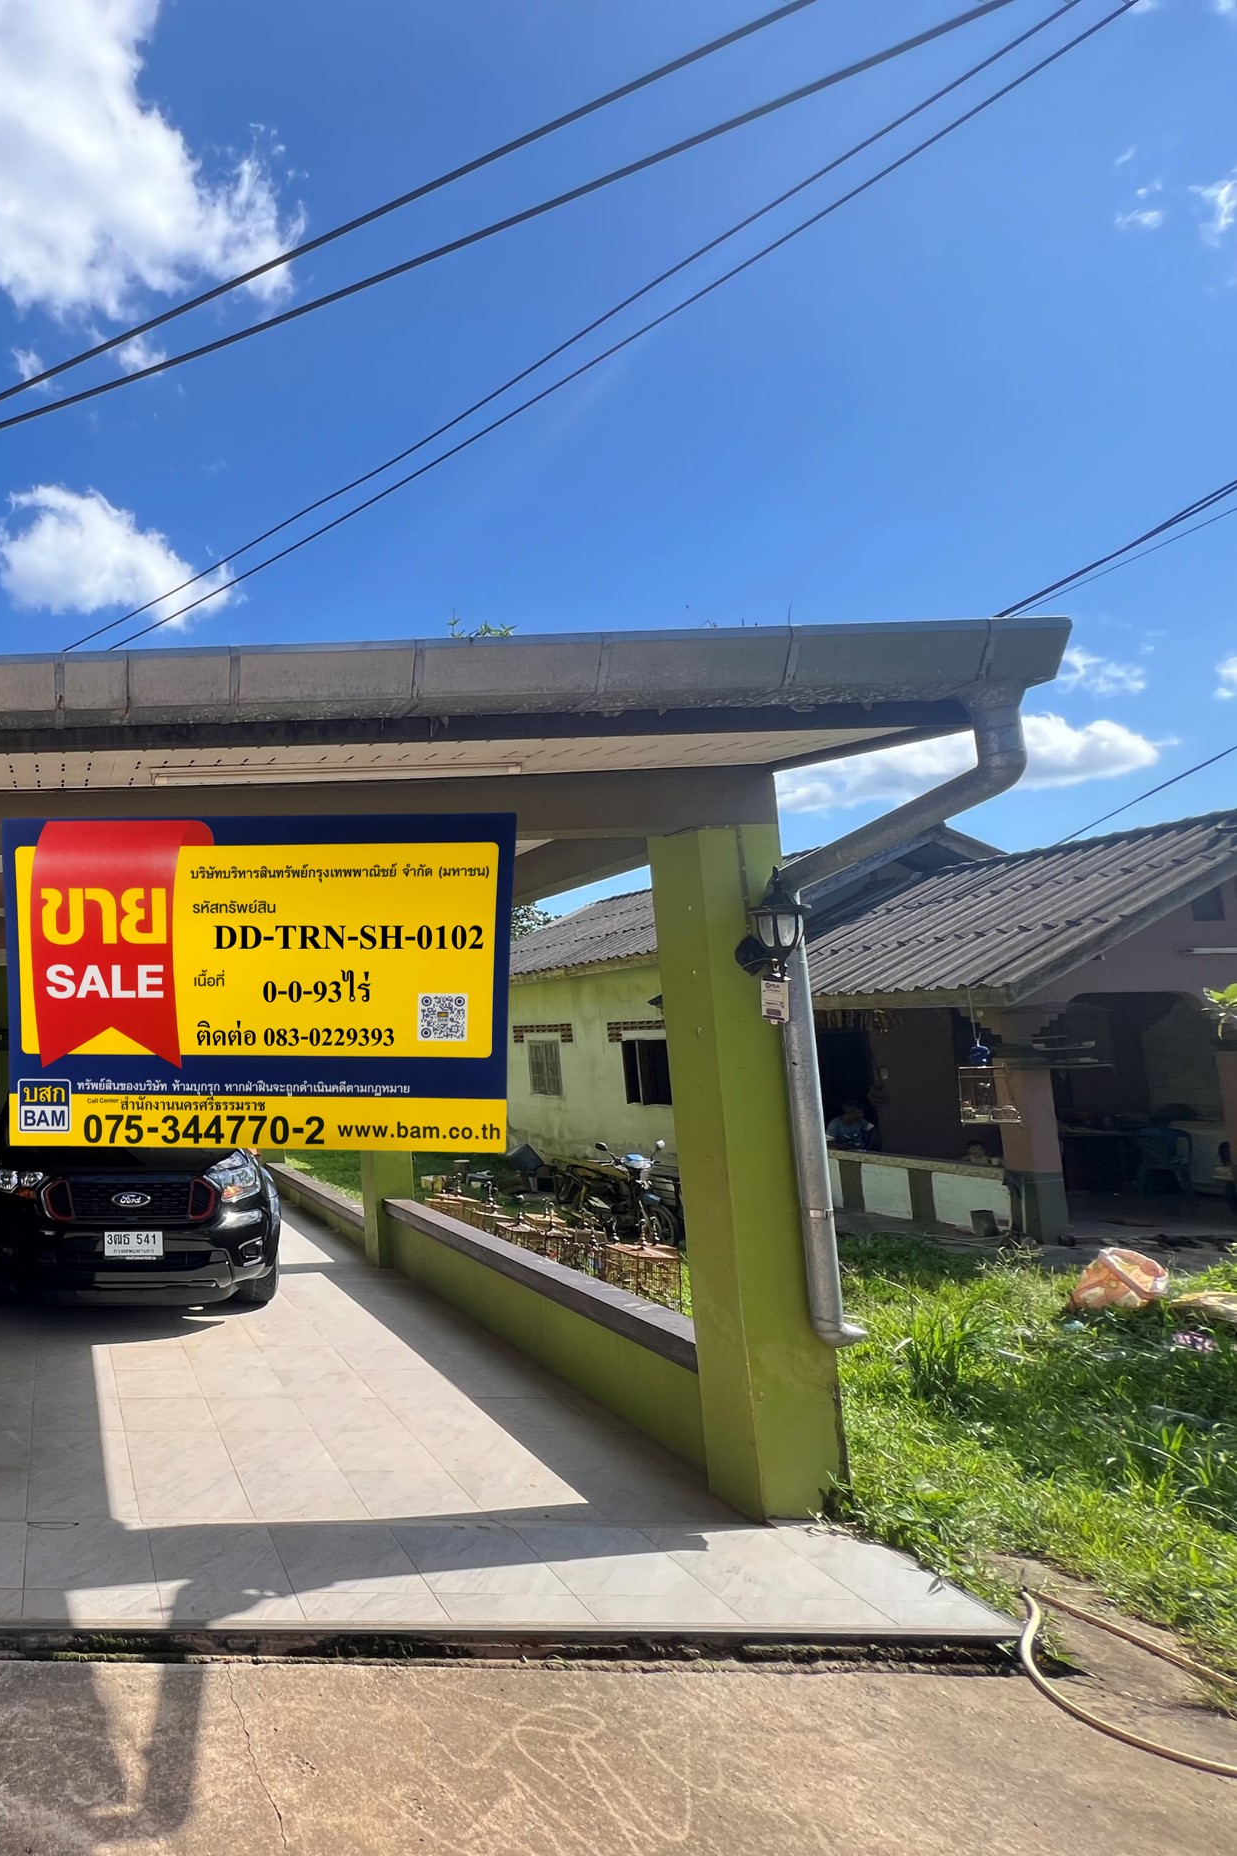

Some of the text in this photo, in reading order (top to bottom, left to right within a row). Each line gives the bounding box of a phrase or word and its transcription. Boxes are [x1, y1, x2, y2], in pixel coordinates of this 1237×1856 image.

[190, 863, 490, 883] บริษัทบริหารสินทรัพย์กรุงเทพพาณิชย์ จำกัด (มหาชน)
[192, 899, 276, 914] รหัสทรัพย์สิน
[40, 887, 167, 945] ขาย
[213, 924, 484, 950] DD-TRN-SH-0102
[46, 964, 164, 999] SALE
[193, 970, 225, 987] เนื้อที่
[196, 1020, 395, 1047] ติดต่อ 083-0229393
[23, 1086, 66, 1103] บสก
[77, 1080, 410, 1097] ทรัพย์สินของบริษัท ห้ามบุกรุก หากฝ่าฝืนจะถูกดำเนินคดีตามกฎหมาย
[120, 1096, 266, 1112] สำนักงานนครศรีธรรมราช
[24, 1110, 66, 1127] BAM
[83, 1114, 501, 1145] 075-344770-2 www.bam.co.th
[120, 1194, 141, 1204] Ford
[136, 1234, 156, 1245] 541
